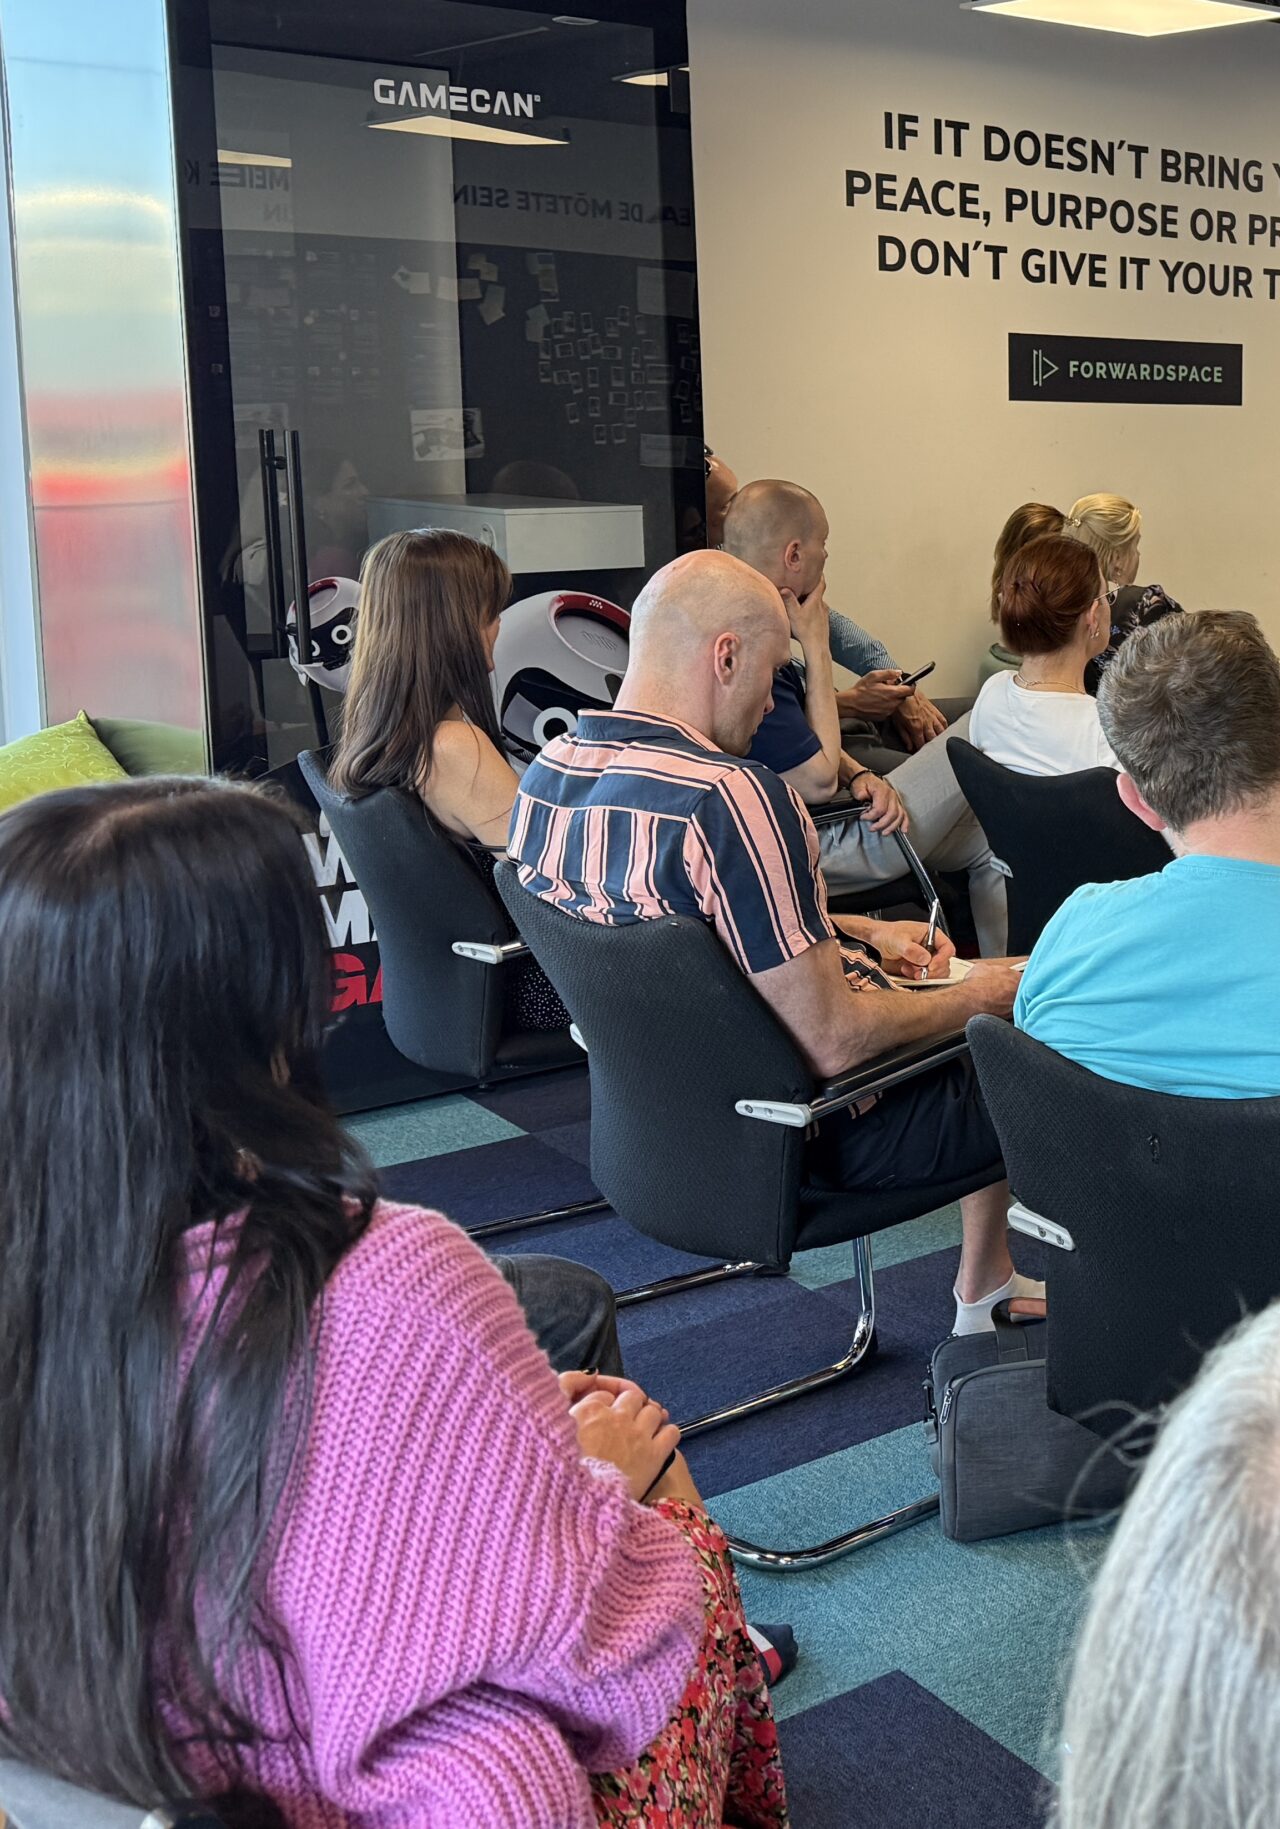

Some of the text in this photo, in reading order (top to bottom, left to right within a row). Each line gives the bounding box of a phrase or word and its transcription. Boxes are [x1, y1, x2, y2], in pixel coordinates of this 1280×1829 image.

[884, 111, 919, 151] IF
[933, 118, 970, 158] IT
[1160, 148, 1264, 193] BRING
[845, 169, 991, 228] PEACE,
[1005, 187, 1179, 239] PURPOSE
[1189, 208, 1237, 245] OR
[1021, 248, 1107, 288] GIVE
[1119, 256, 1151, 291] IT
[1158, 259, 1253, 299] YOUR
[1069, 361, 1223, 383] FORWARDSPACE
